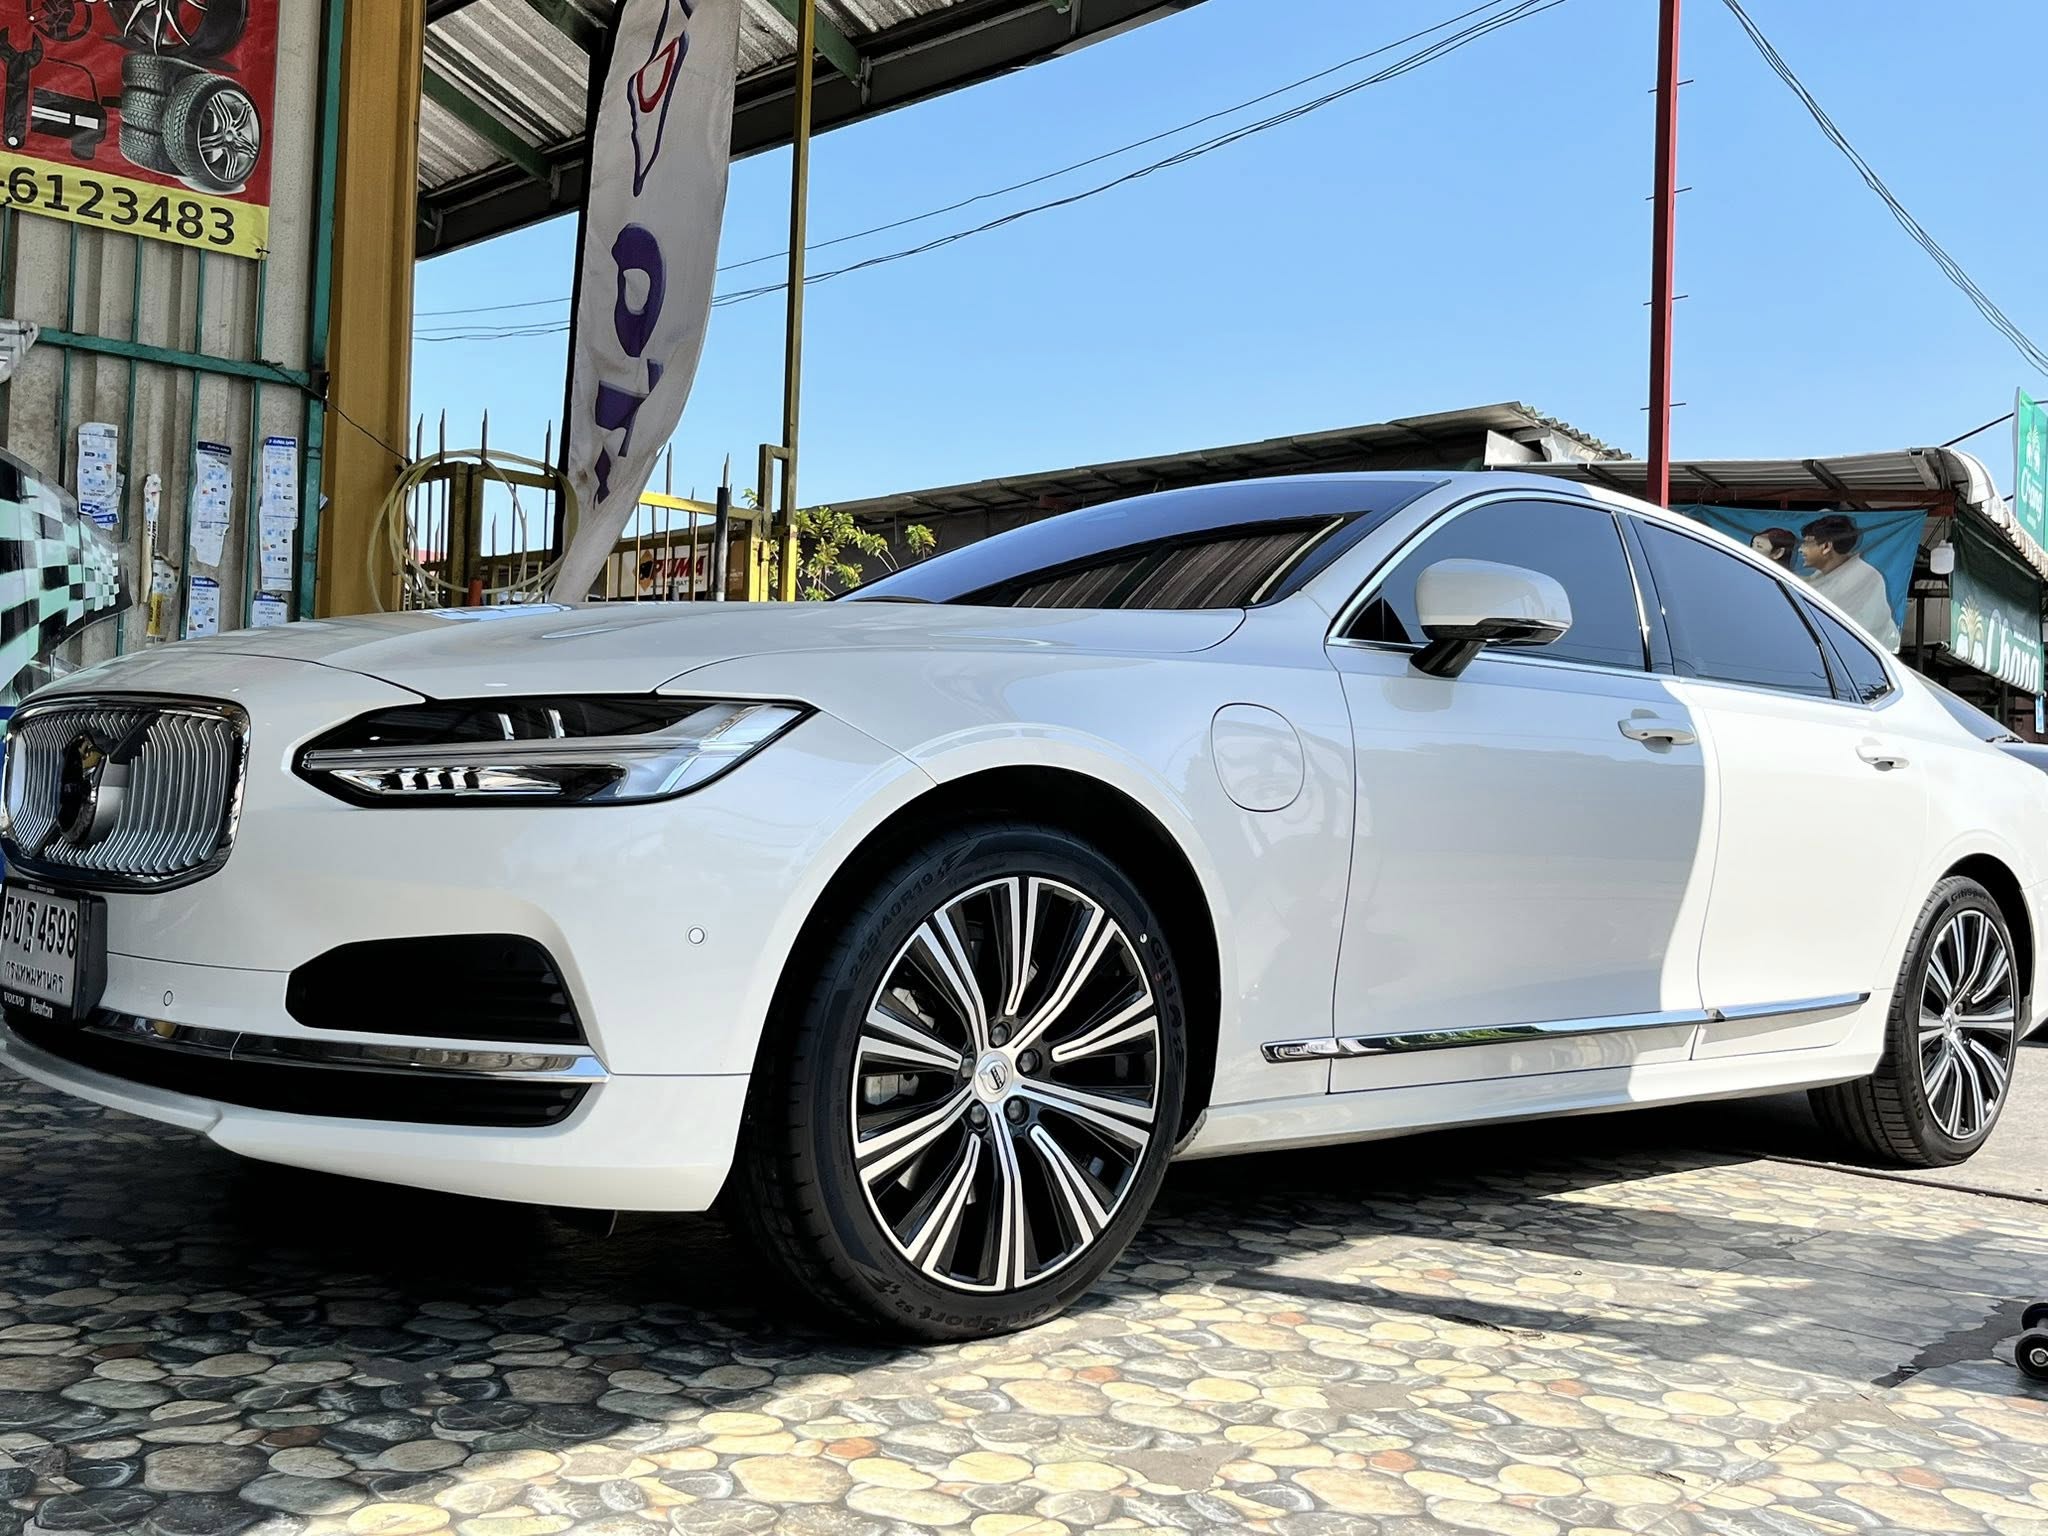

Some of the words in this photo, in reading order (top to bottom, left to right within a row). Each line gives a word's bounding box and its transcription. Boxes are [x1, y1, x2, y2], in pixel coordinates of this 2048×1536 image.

[650, 555, 706, 579] PUMA
[38, 903, 78, 959] 4598
[4, 991, 25, 1007] VOLVO
